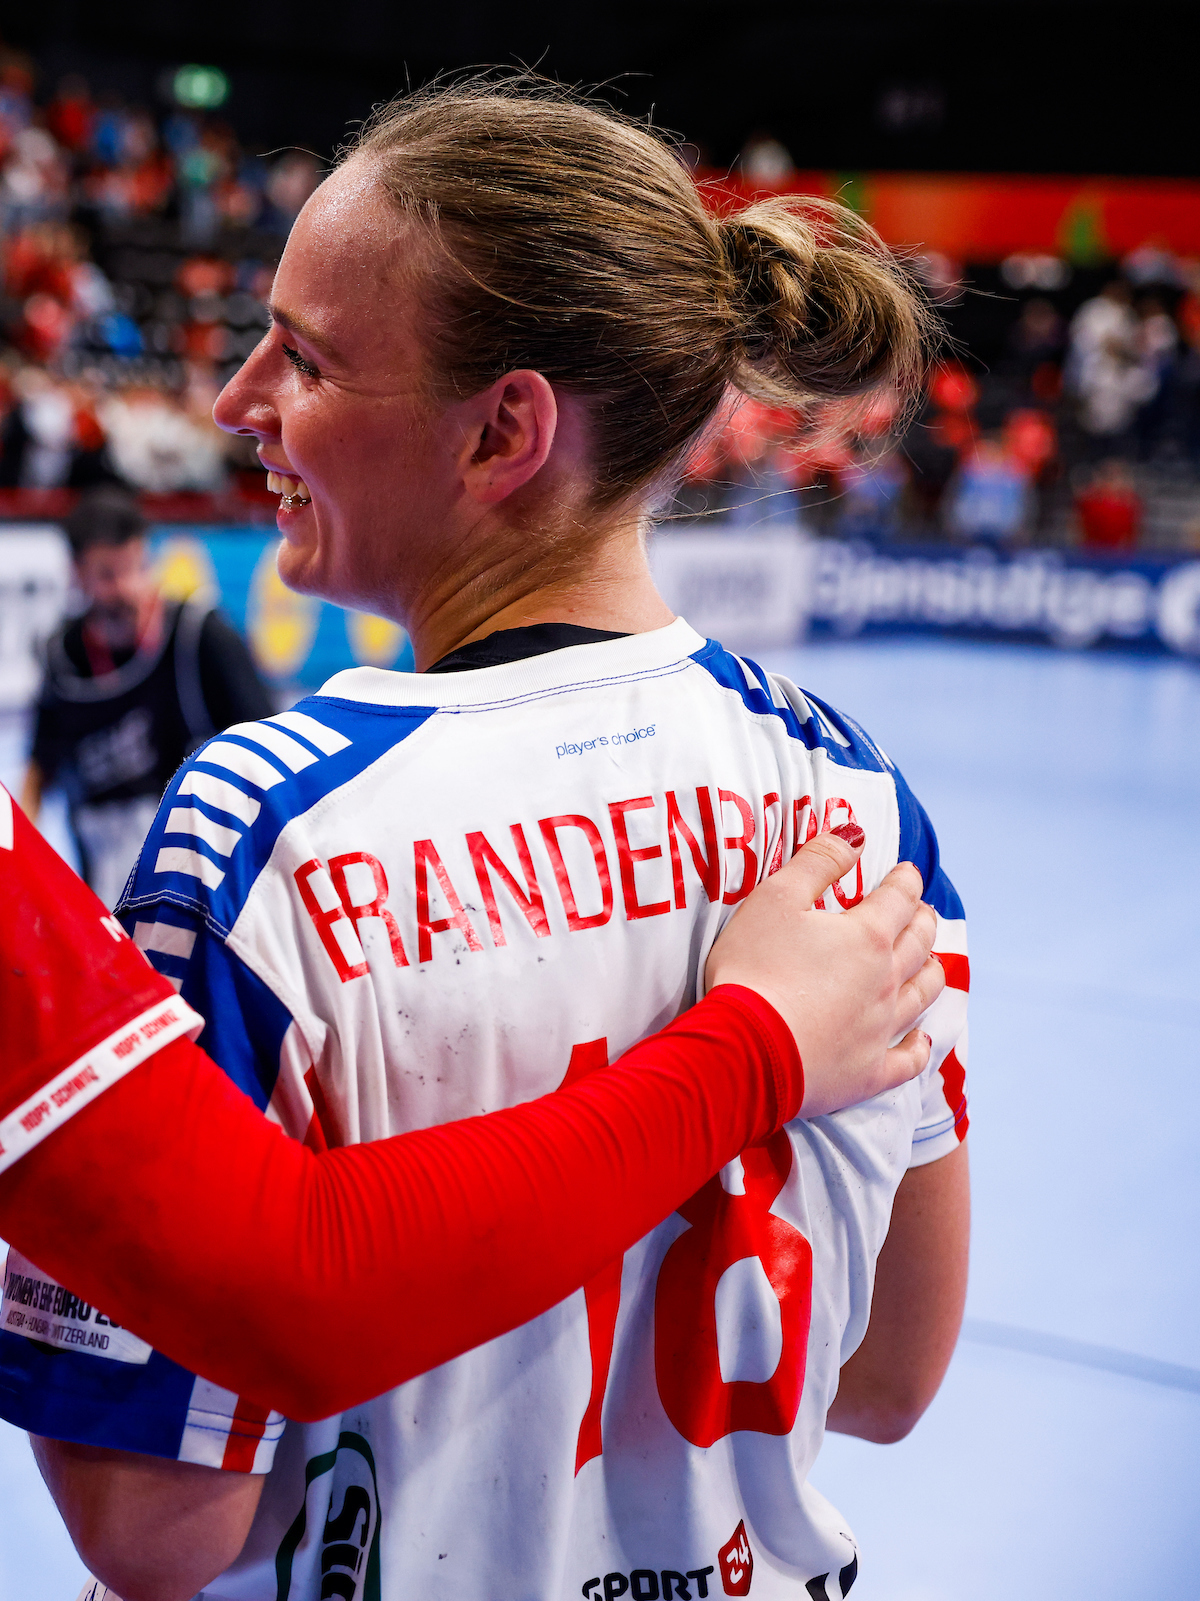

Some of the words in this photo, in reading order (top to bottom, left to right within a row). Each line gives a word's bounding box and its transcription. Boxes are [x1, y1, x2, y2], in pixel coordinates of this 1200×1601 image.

[555, 736, 609, 759] player's
[557, 1036, 814, 1480] 18
[28, 1316, 50, 1335] HUNGAR
[51, 1322, 110, 1351] ITZERLAND
